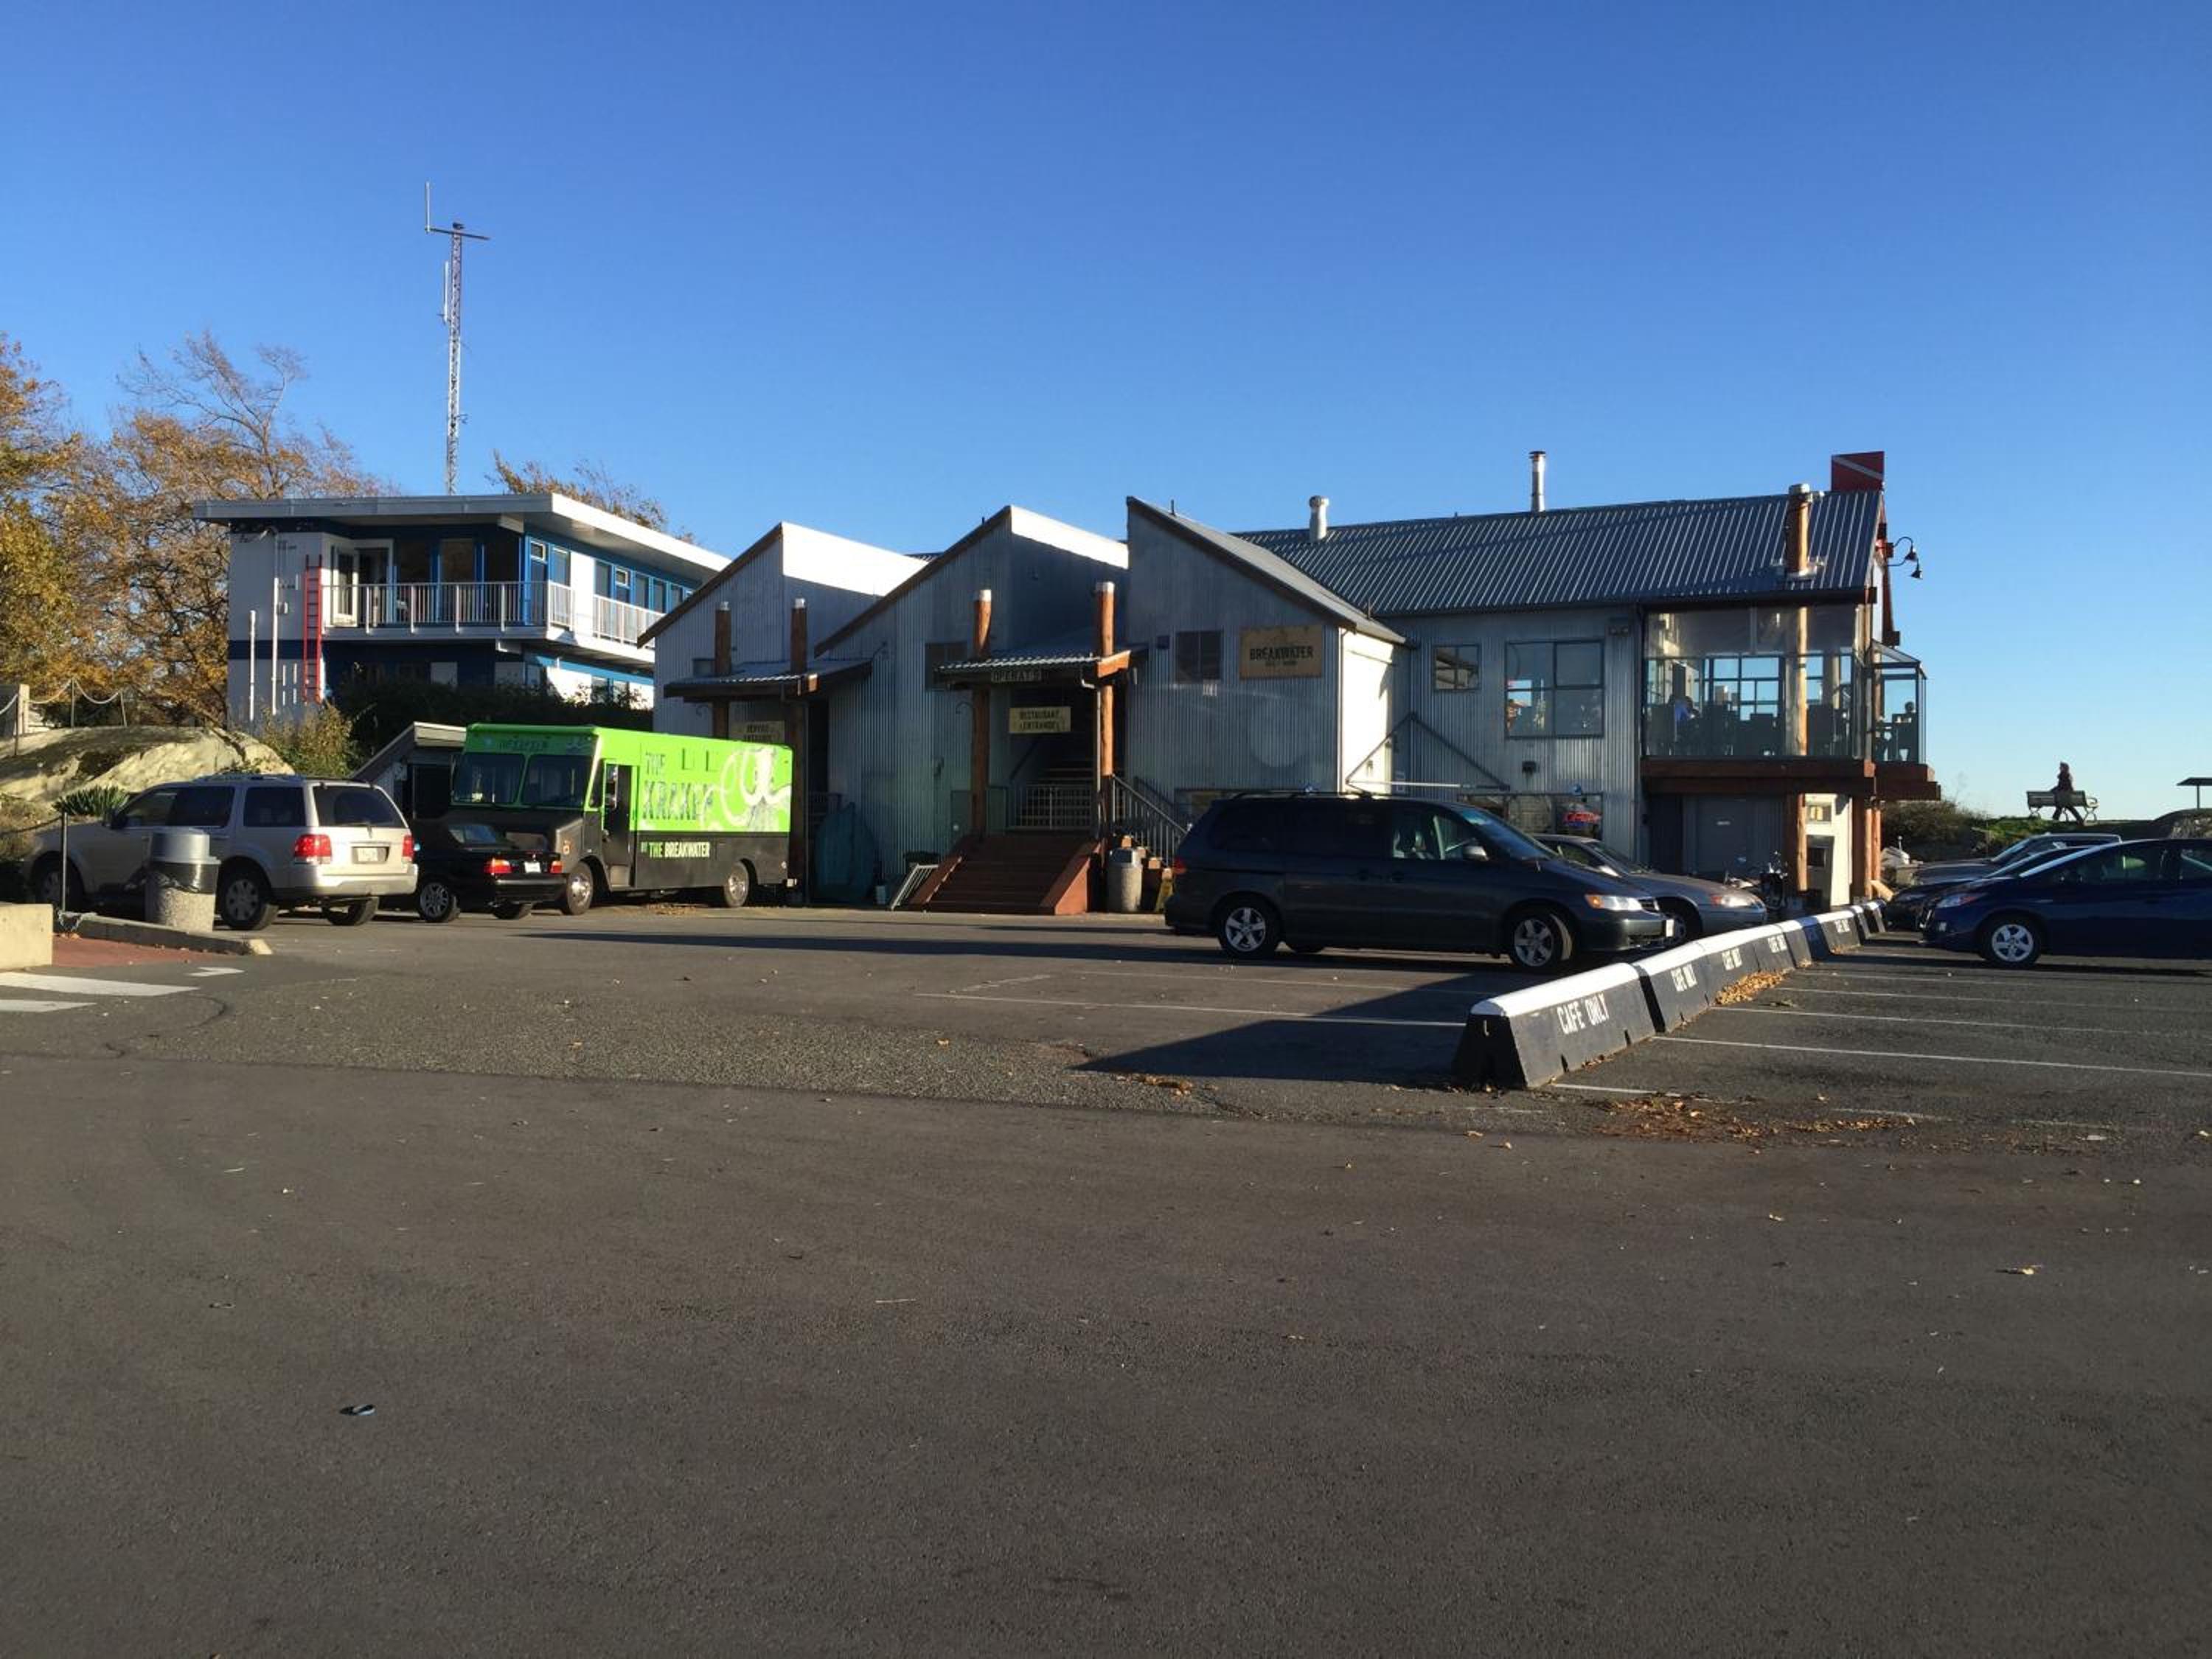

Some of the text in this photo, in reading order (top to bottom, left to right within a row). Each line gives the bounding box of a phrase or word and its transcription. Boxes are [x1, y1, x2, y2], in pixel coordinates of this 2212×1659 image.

[1250, 645, 1314, 661] BREAKWATER
[645, 751, 666, 775] THE
[649, 841, 663, 858] THE
[664, 841, 710, 858] BREAKWATER
[1557, 992, 1609, 1034] CAFE ONLY
